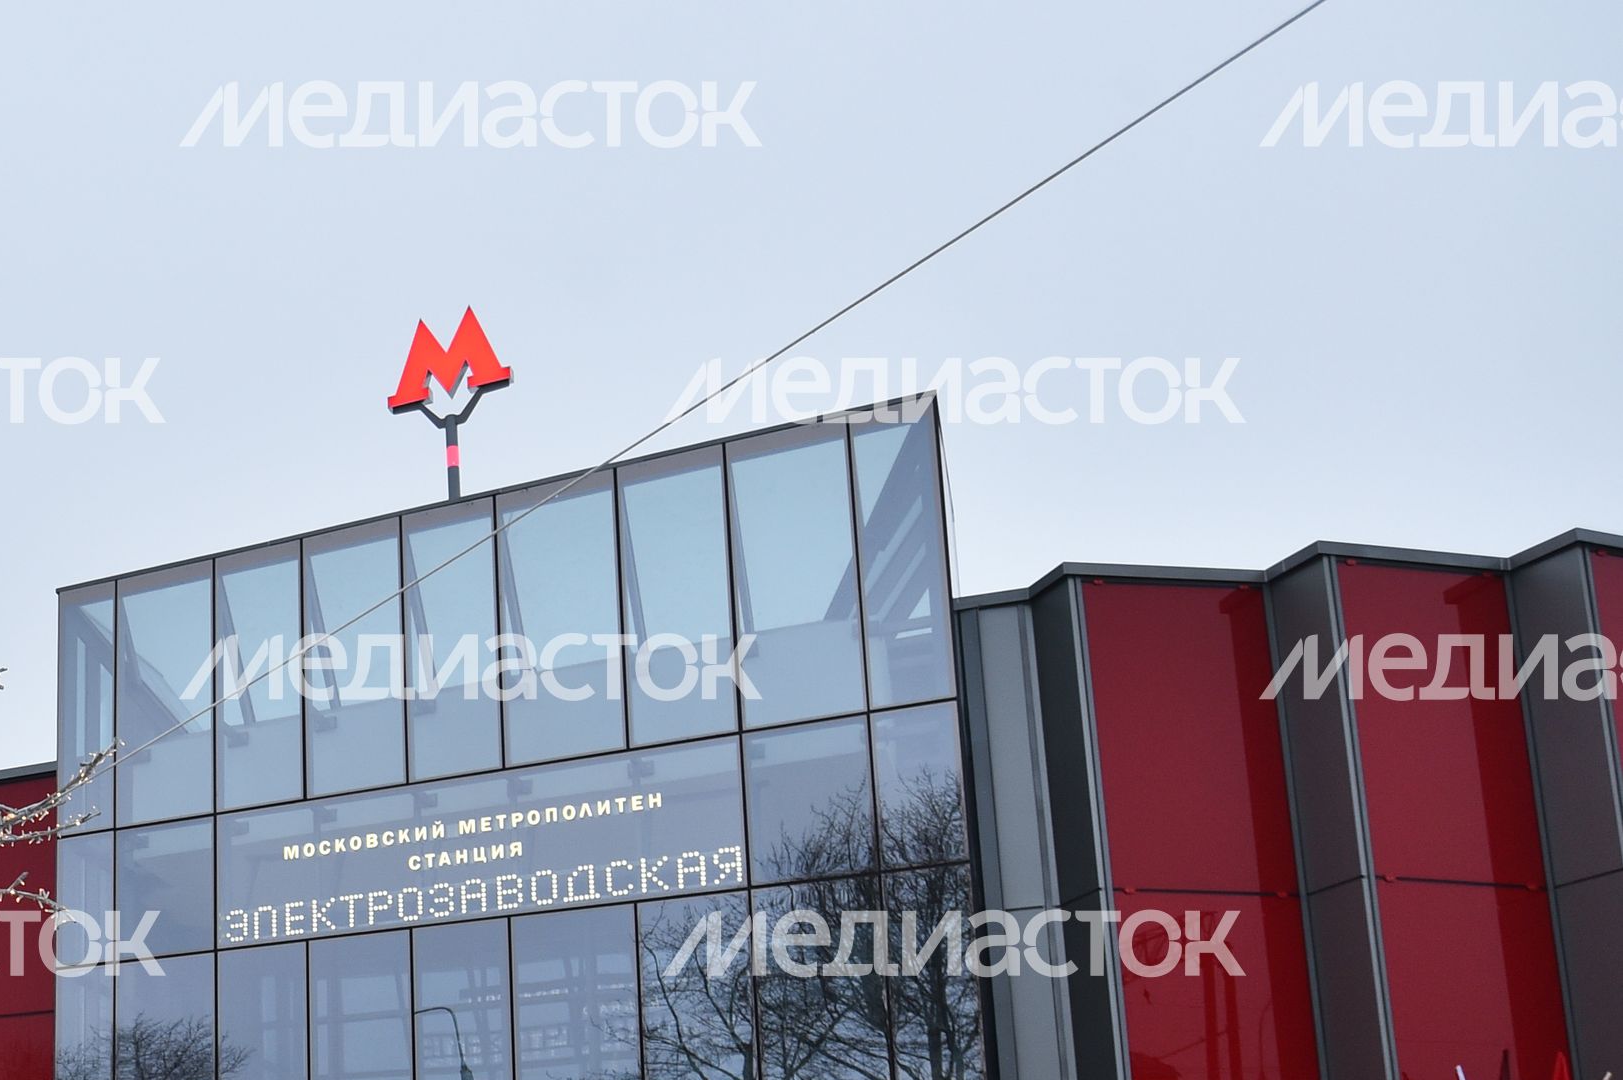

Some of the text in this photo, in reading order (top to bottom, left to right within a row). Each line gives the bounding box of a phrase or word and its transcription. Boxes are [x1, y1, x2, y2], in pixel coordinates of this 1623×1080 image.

[282, 792, 664, 861] МОСКОВСКИЙ МЕТРОПОЛИТЕН
[407, 841, 525, 871] СТАНЦИЯ
[224, 845, 744, 943] ЭЛЕКТРОЗАВОДСКАЯ
